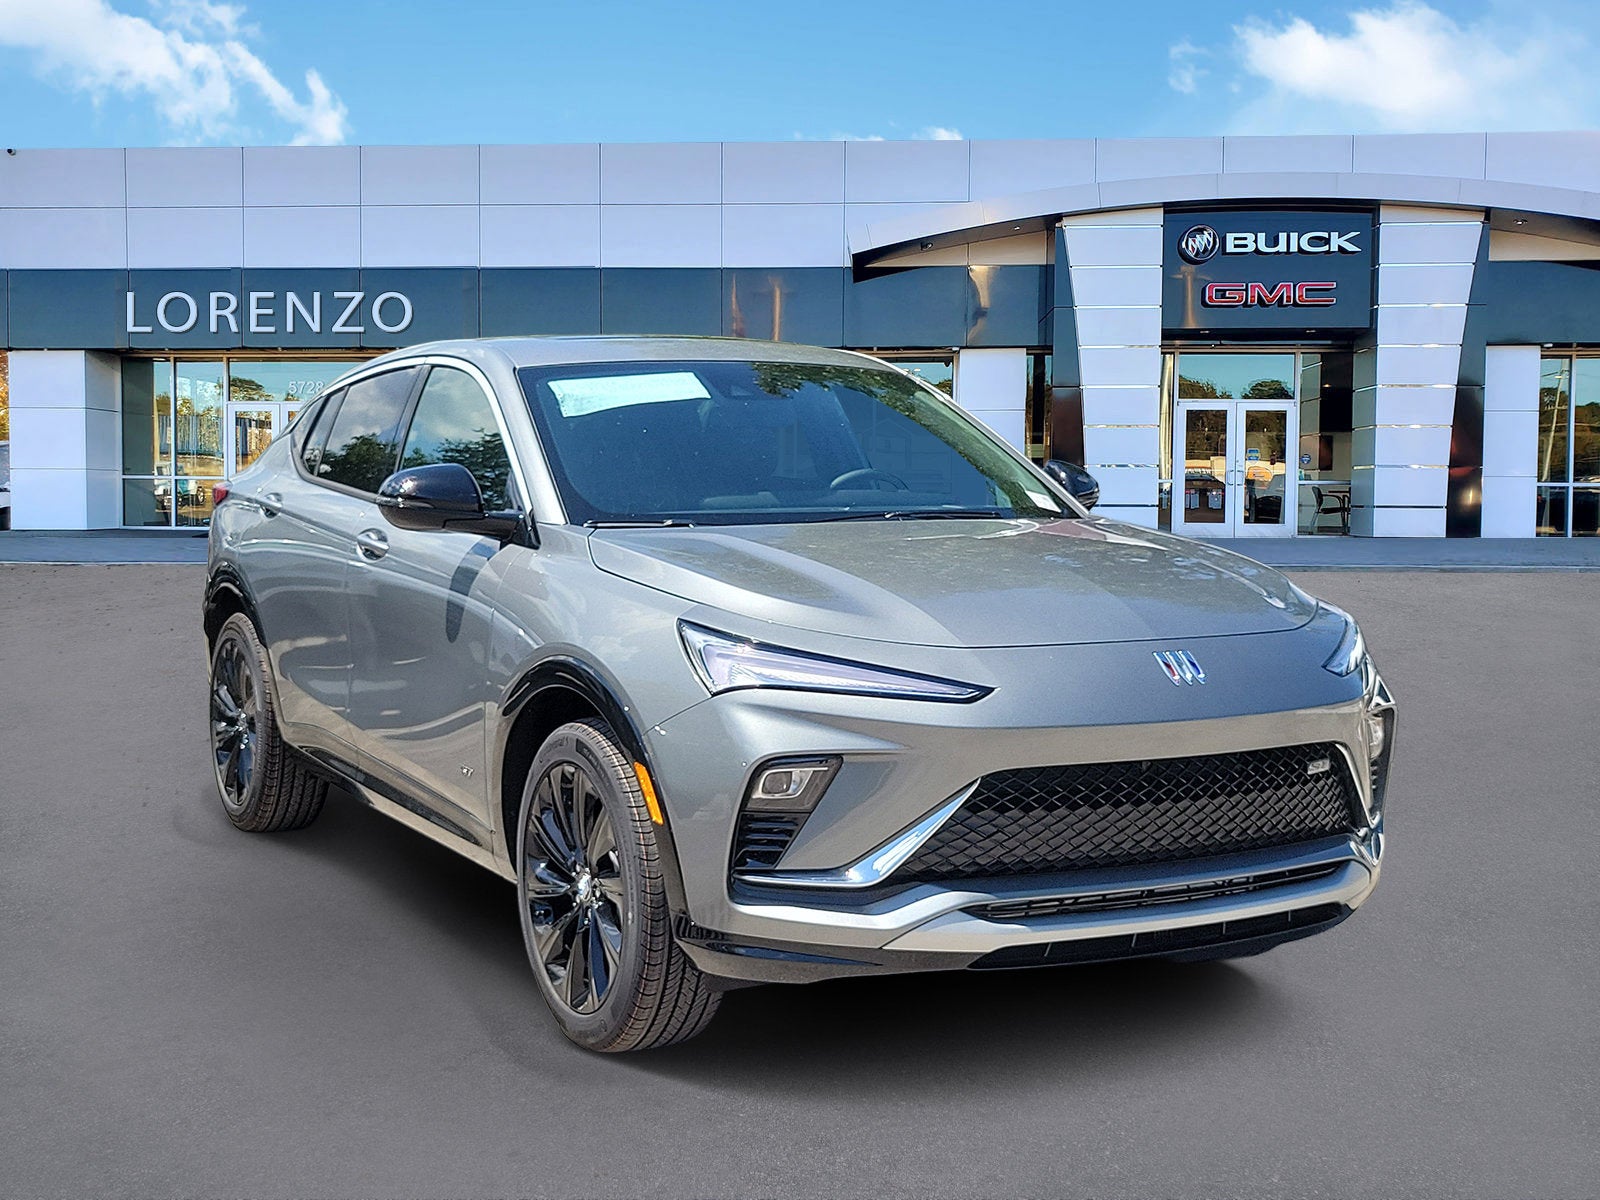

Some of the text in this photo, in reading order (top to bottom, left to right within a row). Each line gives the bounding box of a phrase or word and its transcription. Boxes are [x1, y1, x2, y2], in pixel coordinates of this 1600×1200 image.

[1225, 231, 1362, 253] BUICK
[1204, 281, 1337, 306] GMC
[125, 290, 414, 334] LORENZO
[287, 380, 325, 395] 5728
